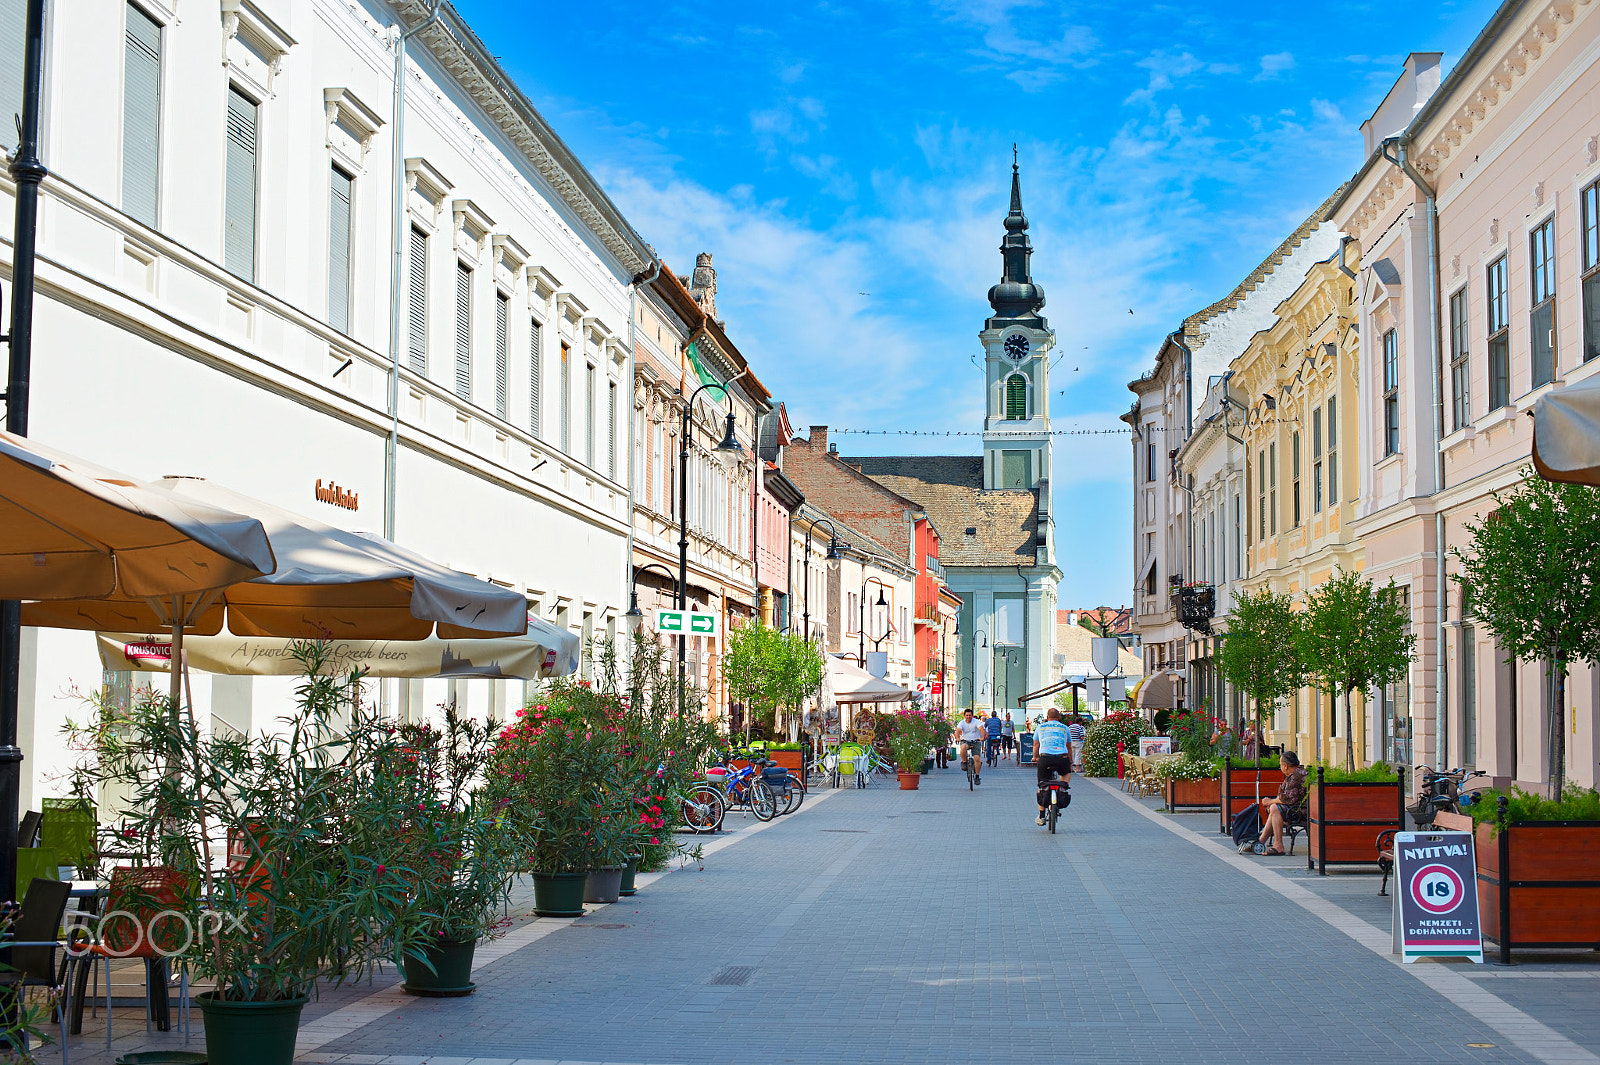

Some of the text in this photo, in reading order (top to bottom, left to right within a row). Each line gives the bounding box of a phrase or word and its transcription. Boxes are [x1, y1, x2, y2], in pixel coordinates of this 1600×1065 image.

[231, 641, 248, 658] A
[333, 640, 375, 662] Czech
[378, 640, 408, 661] beers
[1404, 844, 1468, 860] NYITVA!
[1426, 881, 1450, 897] 18
[1409, 927, 1473, 935] DOHÁNYBOLT
